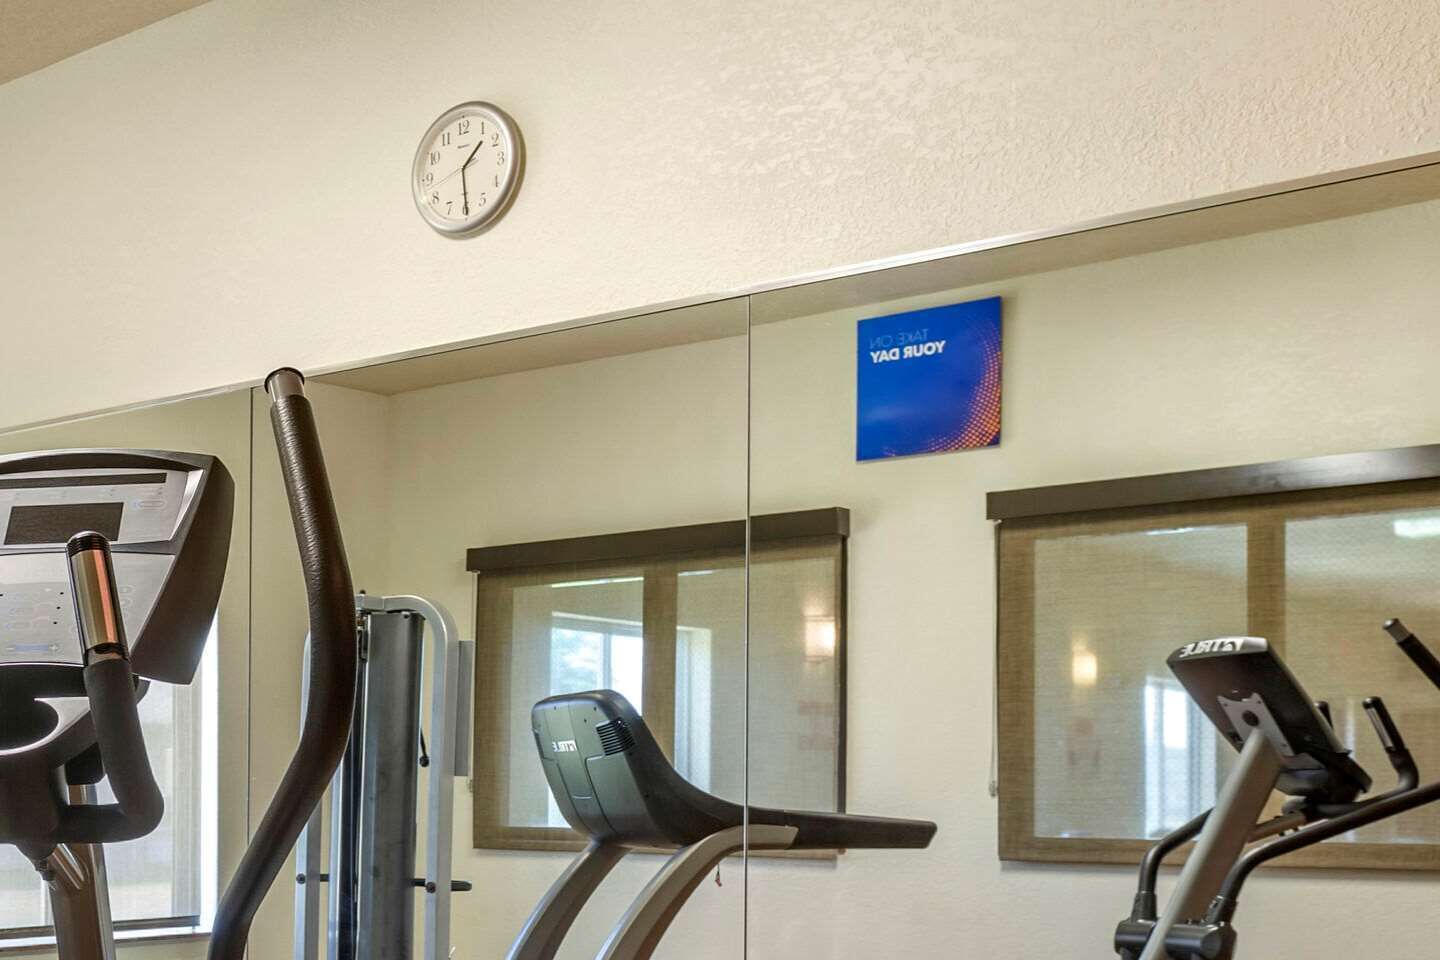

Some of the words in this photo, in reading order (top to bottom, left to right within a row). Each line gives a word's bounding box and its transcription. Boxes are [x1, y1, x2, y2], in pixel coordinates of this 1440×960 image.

[458, 120, 470, 135] 12
[442, 132, 451, 146] 11
[491, 133, 499, 147] 2
[430, 151, 440, 166] 10
[497, 152, 505, 166] 3
[426, 172, 434, 186] 9
[432, 191, 440, 205] 8
[478, 192, 487, 207] 5
[446, 201, 453, 215] 7
